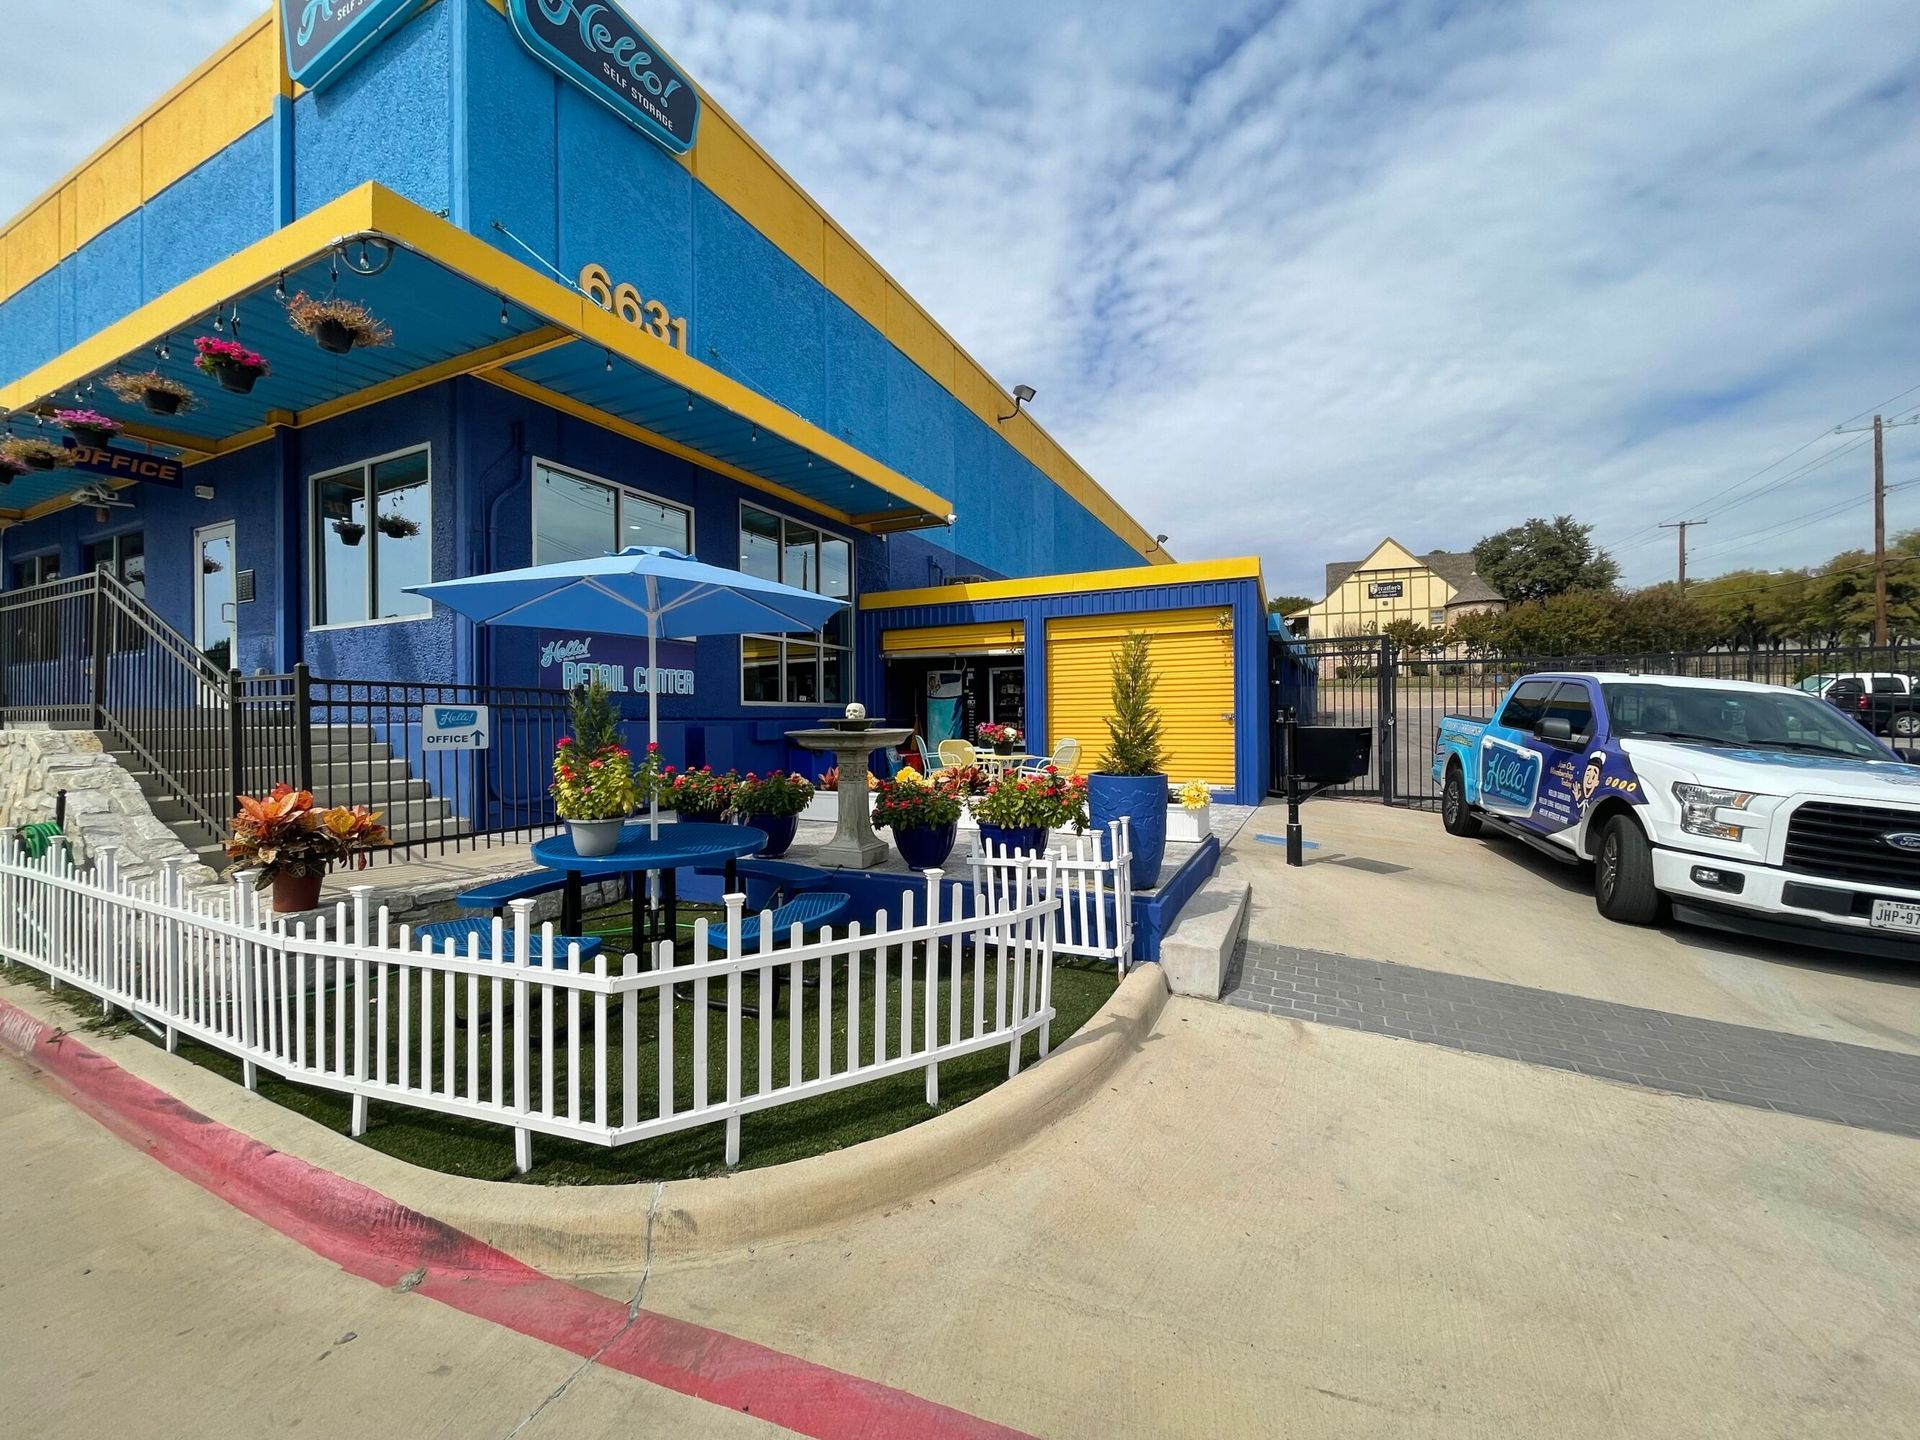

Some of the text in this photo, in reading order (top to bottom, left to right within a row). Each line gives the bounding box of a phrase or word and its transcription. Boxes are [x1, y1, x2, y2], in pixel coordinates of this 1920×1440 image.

[337, 0, 355, 20] SELF
[603, 62, 673, 131] SELF STORAGE
[580, 263, 687, 354] 6631
[541, 637, 592, 667] Hello!
[562, 661, 629, 692] RETAIL
[438, 711, 474, 726] Hello!
[427, 735, 469, 744] OFFICE
[1484, 753, 1534, 793] Hello!
